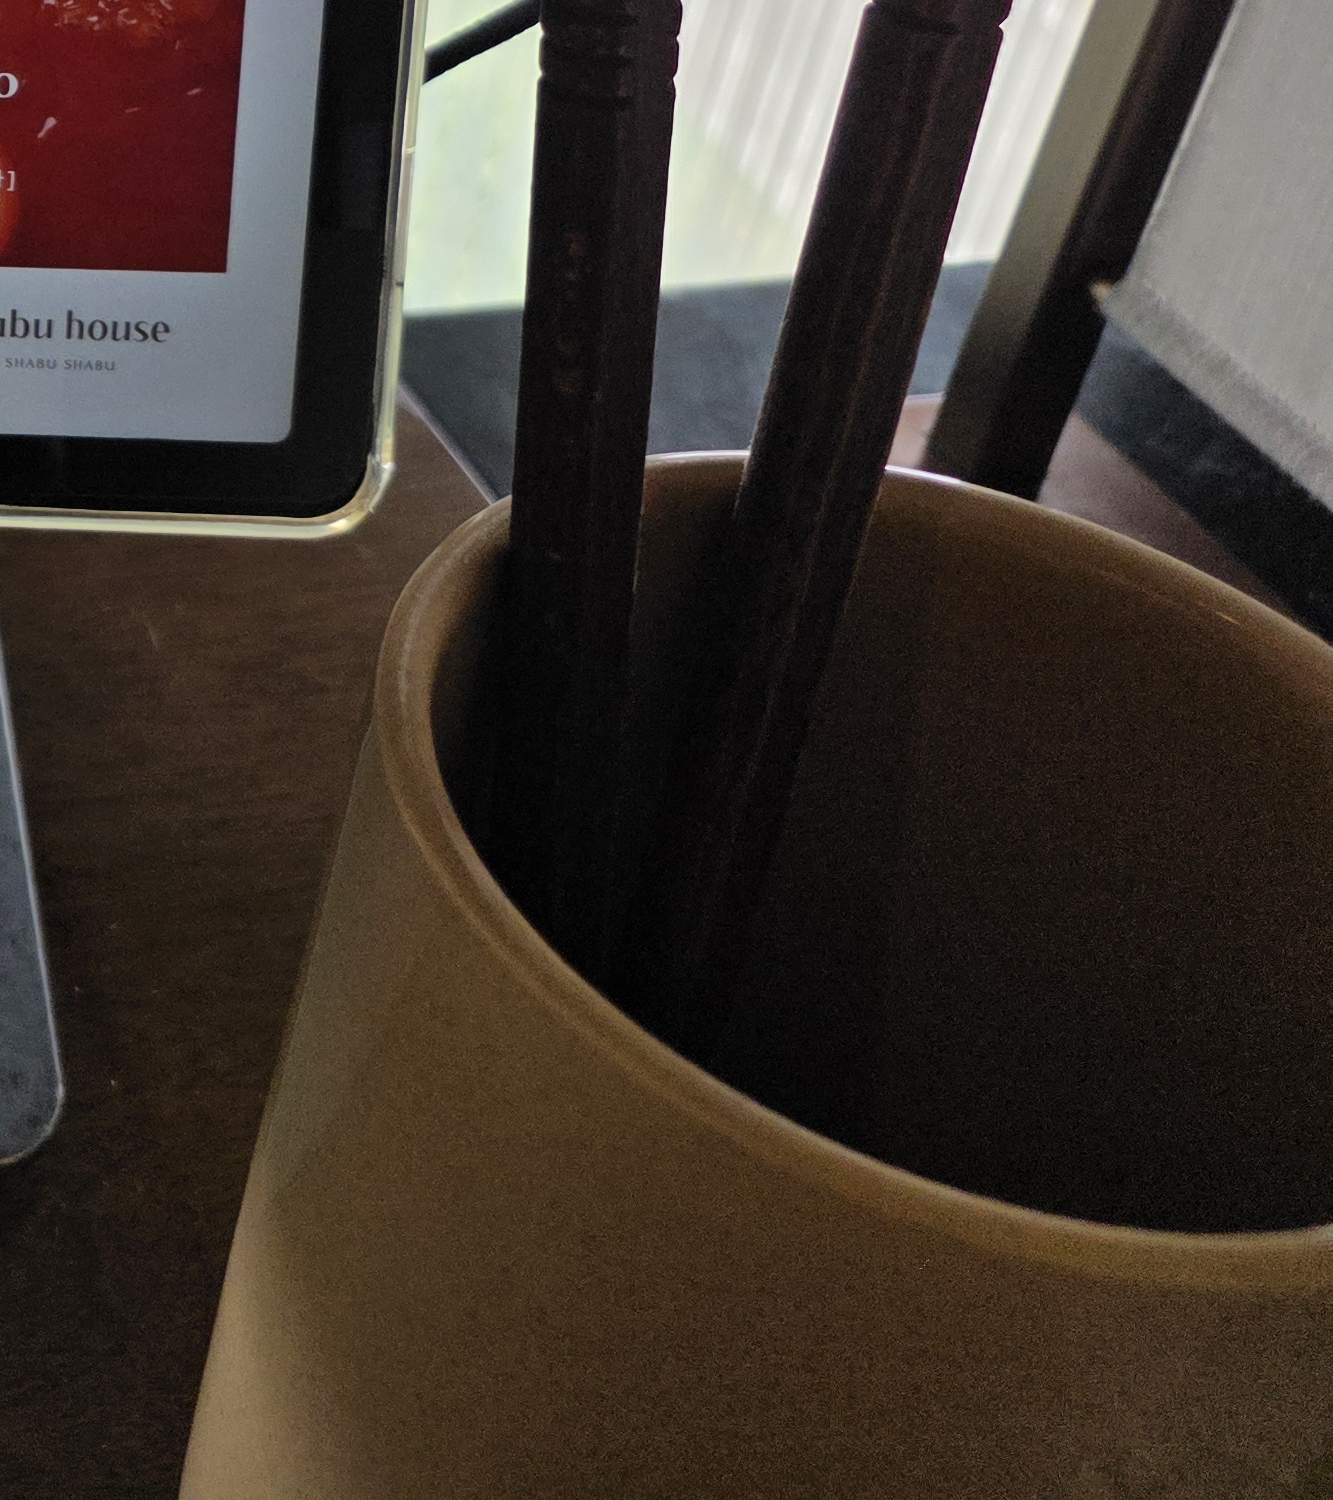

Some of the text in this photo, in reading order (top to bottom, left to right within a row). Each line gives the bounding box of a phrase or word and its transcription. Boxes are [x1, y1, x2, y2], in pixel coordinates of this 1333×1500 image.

[65, 311, 172, 343] house
[5, 357, 57, 370] SHABU
[64, 359, 116, 372] SHABU
